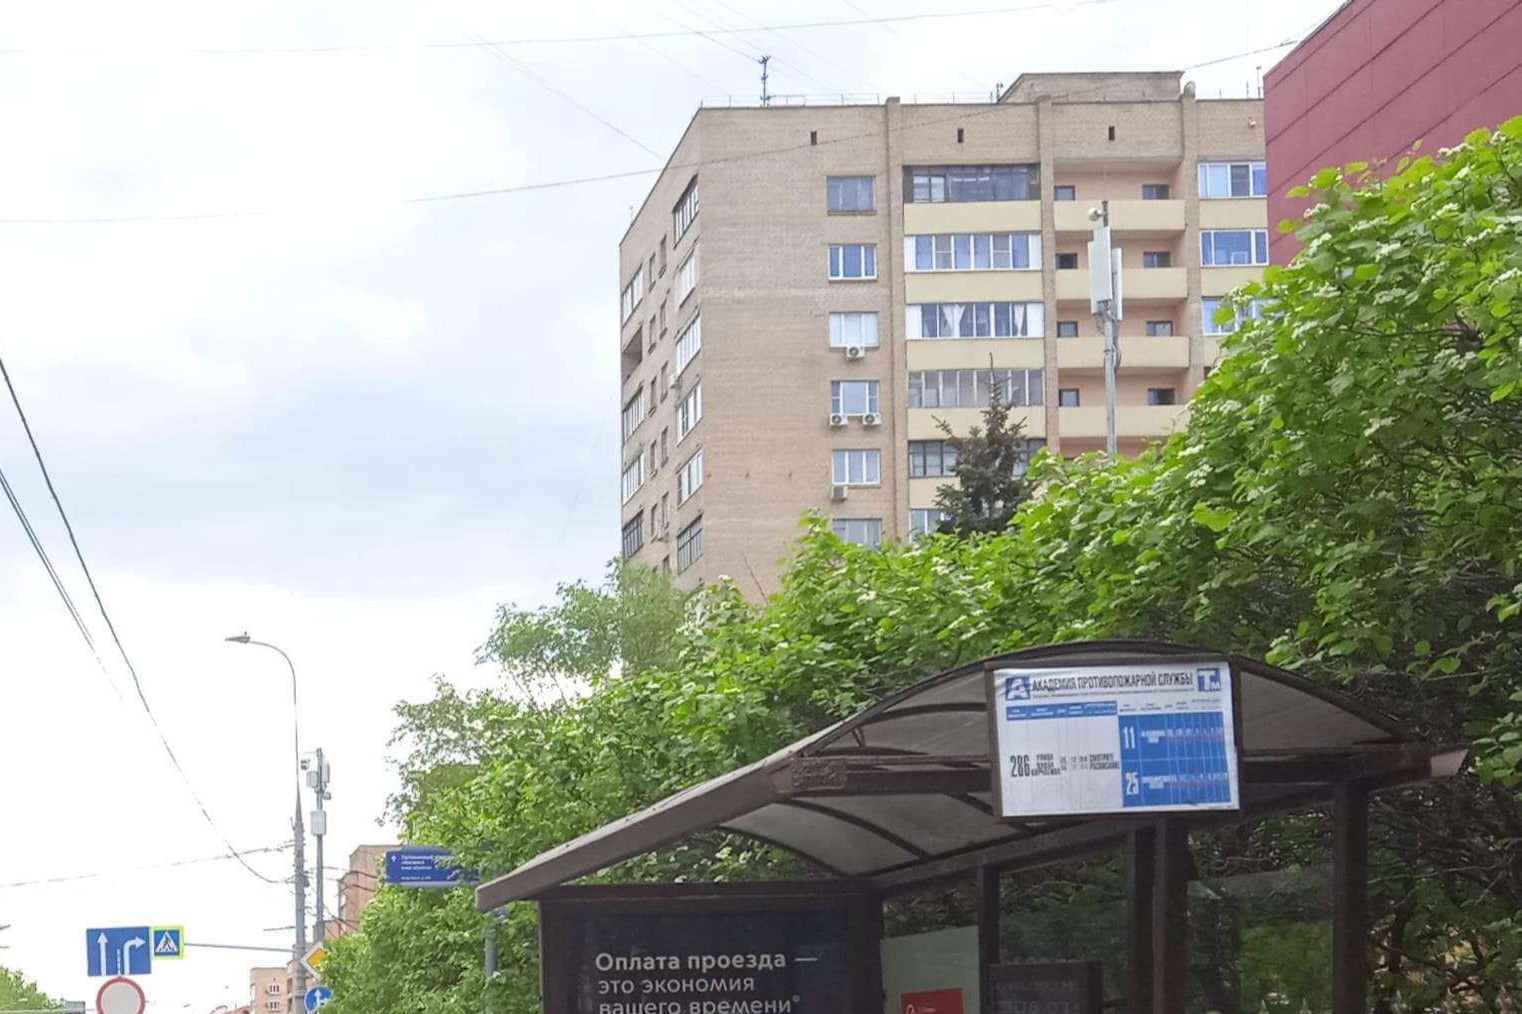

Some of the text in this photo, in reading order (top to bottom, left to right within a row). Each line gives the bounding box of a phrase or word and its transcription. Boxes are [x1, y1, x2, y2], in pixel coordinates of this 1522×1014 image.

[1033, 671, 1193, 692] АКАДЕМИЯ ПРОТИВОПОЖАРНОЙ СЛУЖБЫ
[1123, 726, 1136, 750] 11
[1010, 754, 1030, 777] 286
[1125, 771, 1139, 795] 25
[595, 952, 680, 972] Оплата
[687, 953, 787, 973] проезда
[598, 977, 755, 994] это экономия
